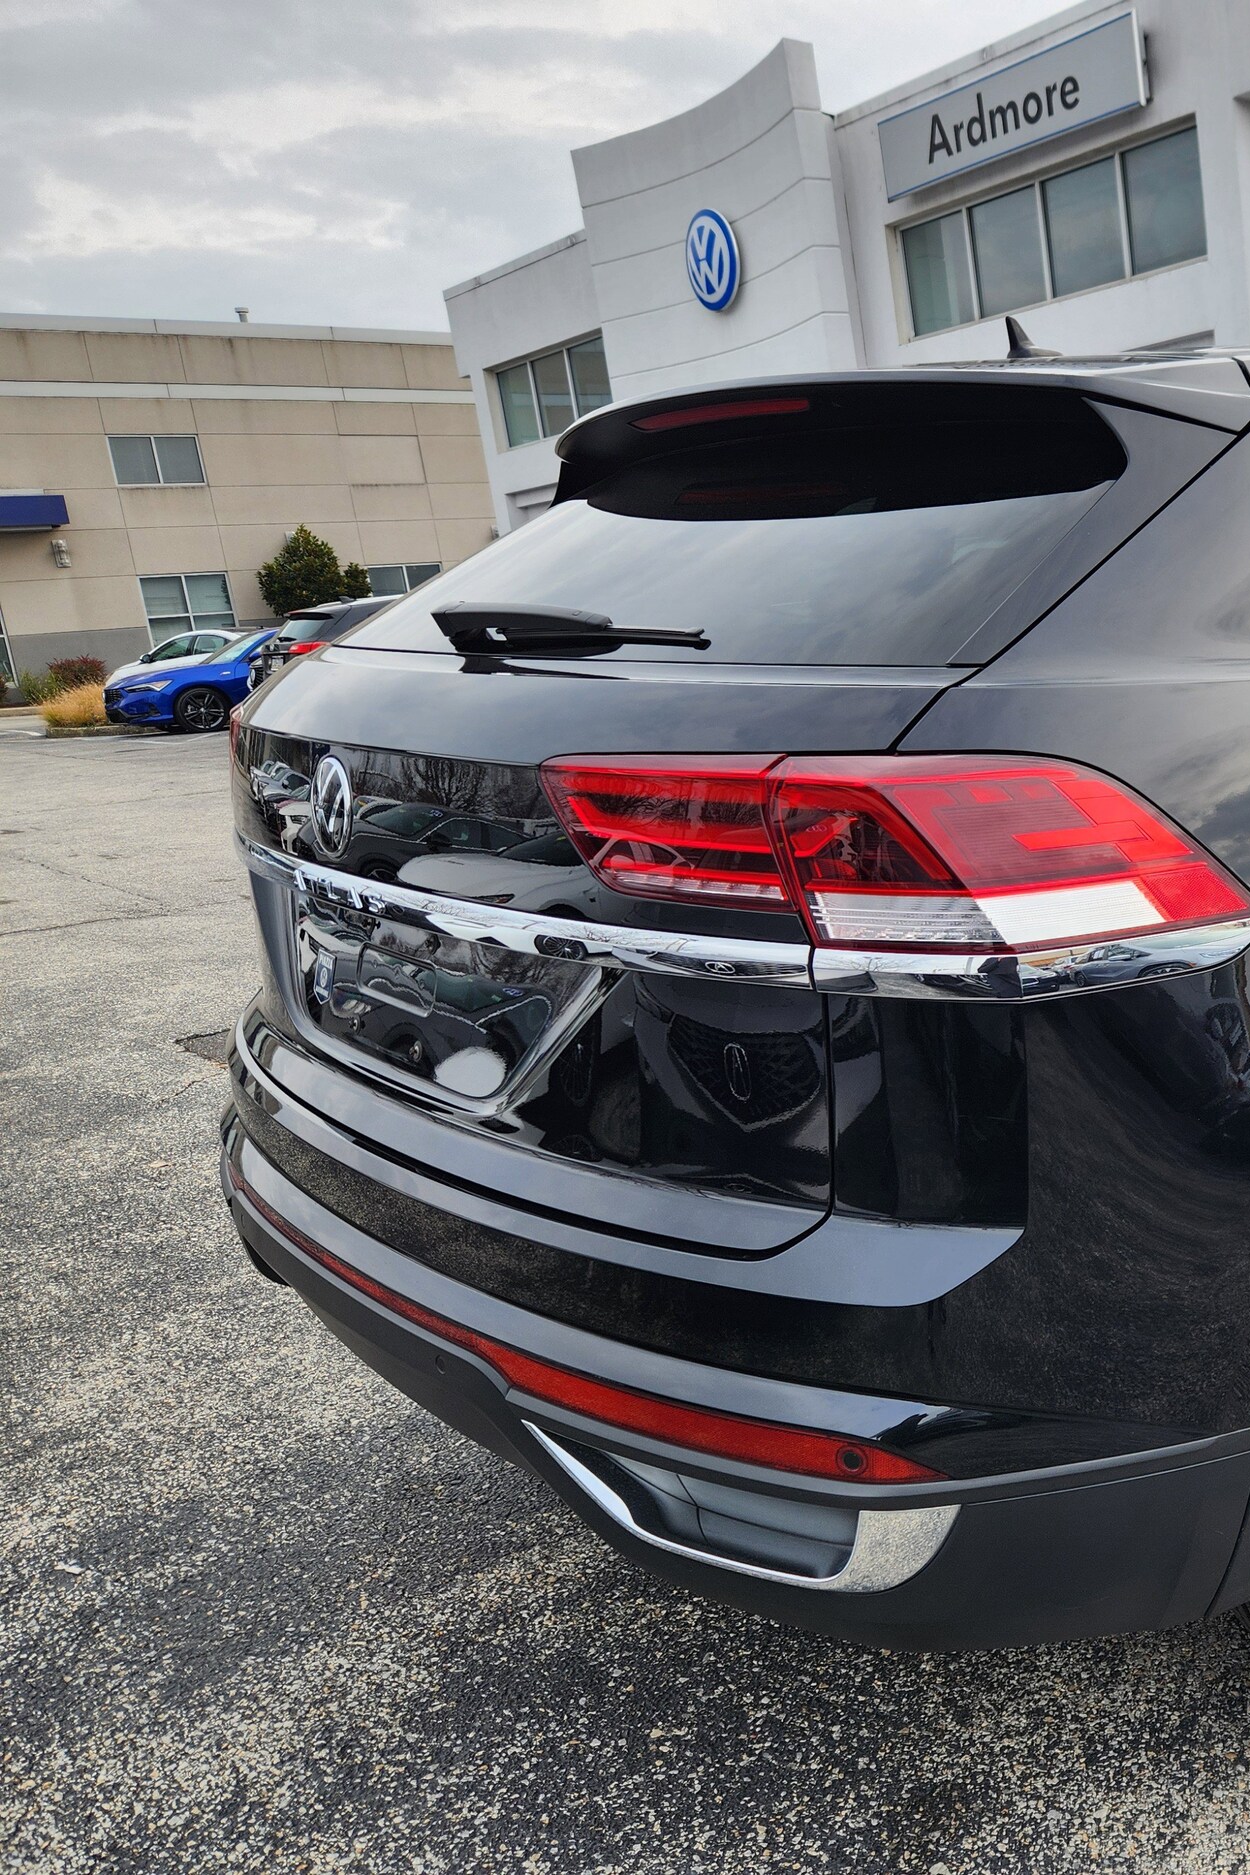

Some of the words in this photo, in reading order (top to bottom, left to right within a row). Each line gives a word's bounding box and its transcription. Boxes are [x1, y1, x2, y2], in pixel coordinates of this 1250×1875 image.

[928, 75, 1080, 165] Ardmore
[688, 215, 731, 304] VW
[312, 756, 352, 858] VW
[293, 869, 387, 916] ATLAS
